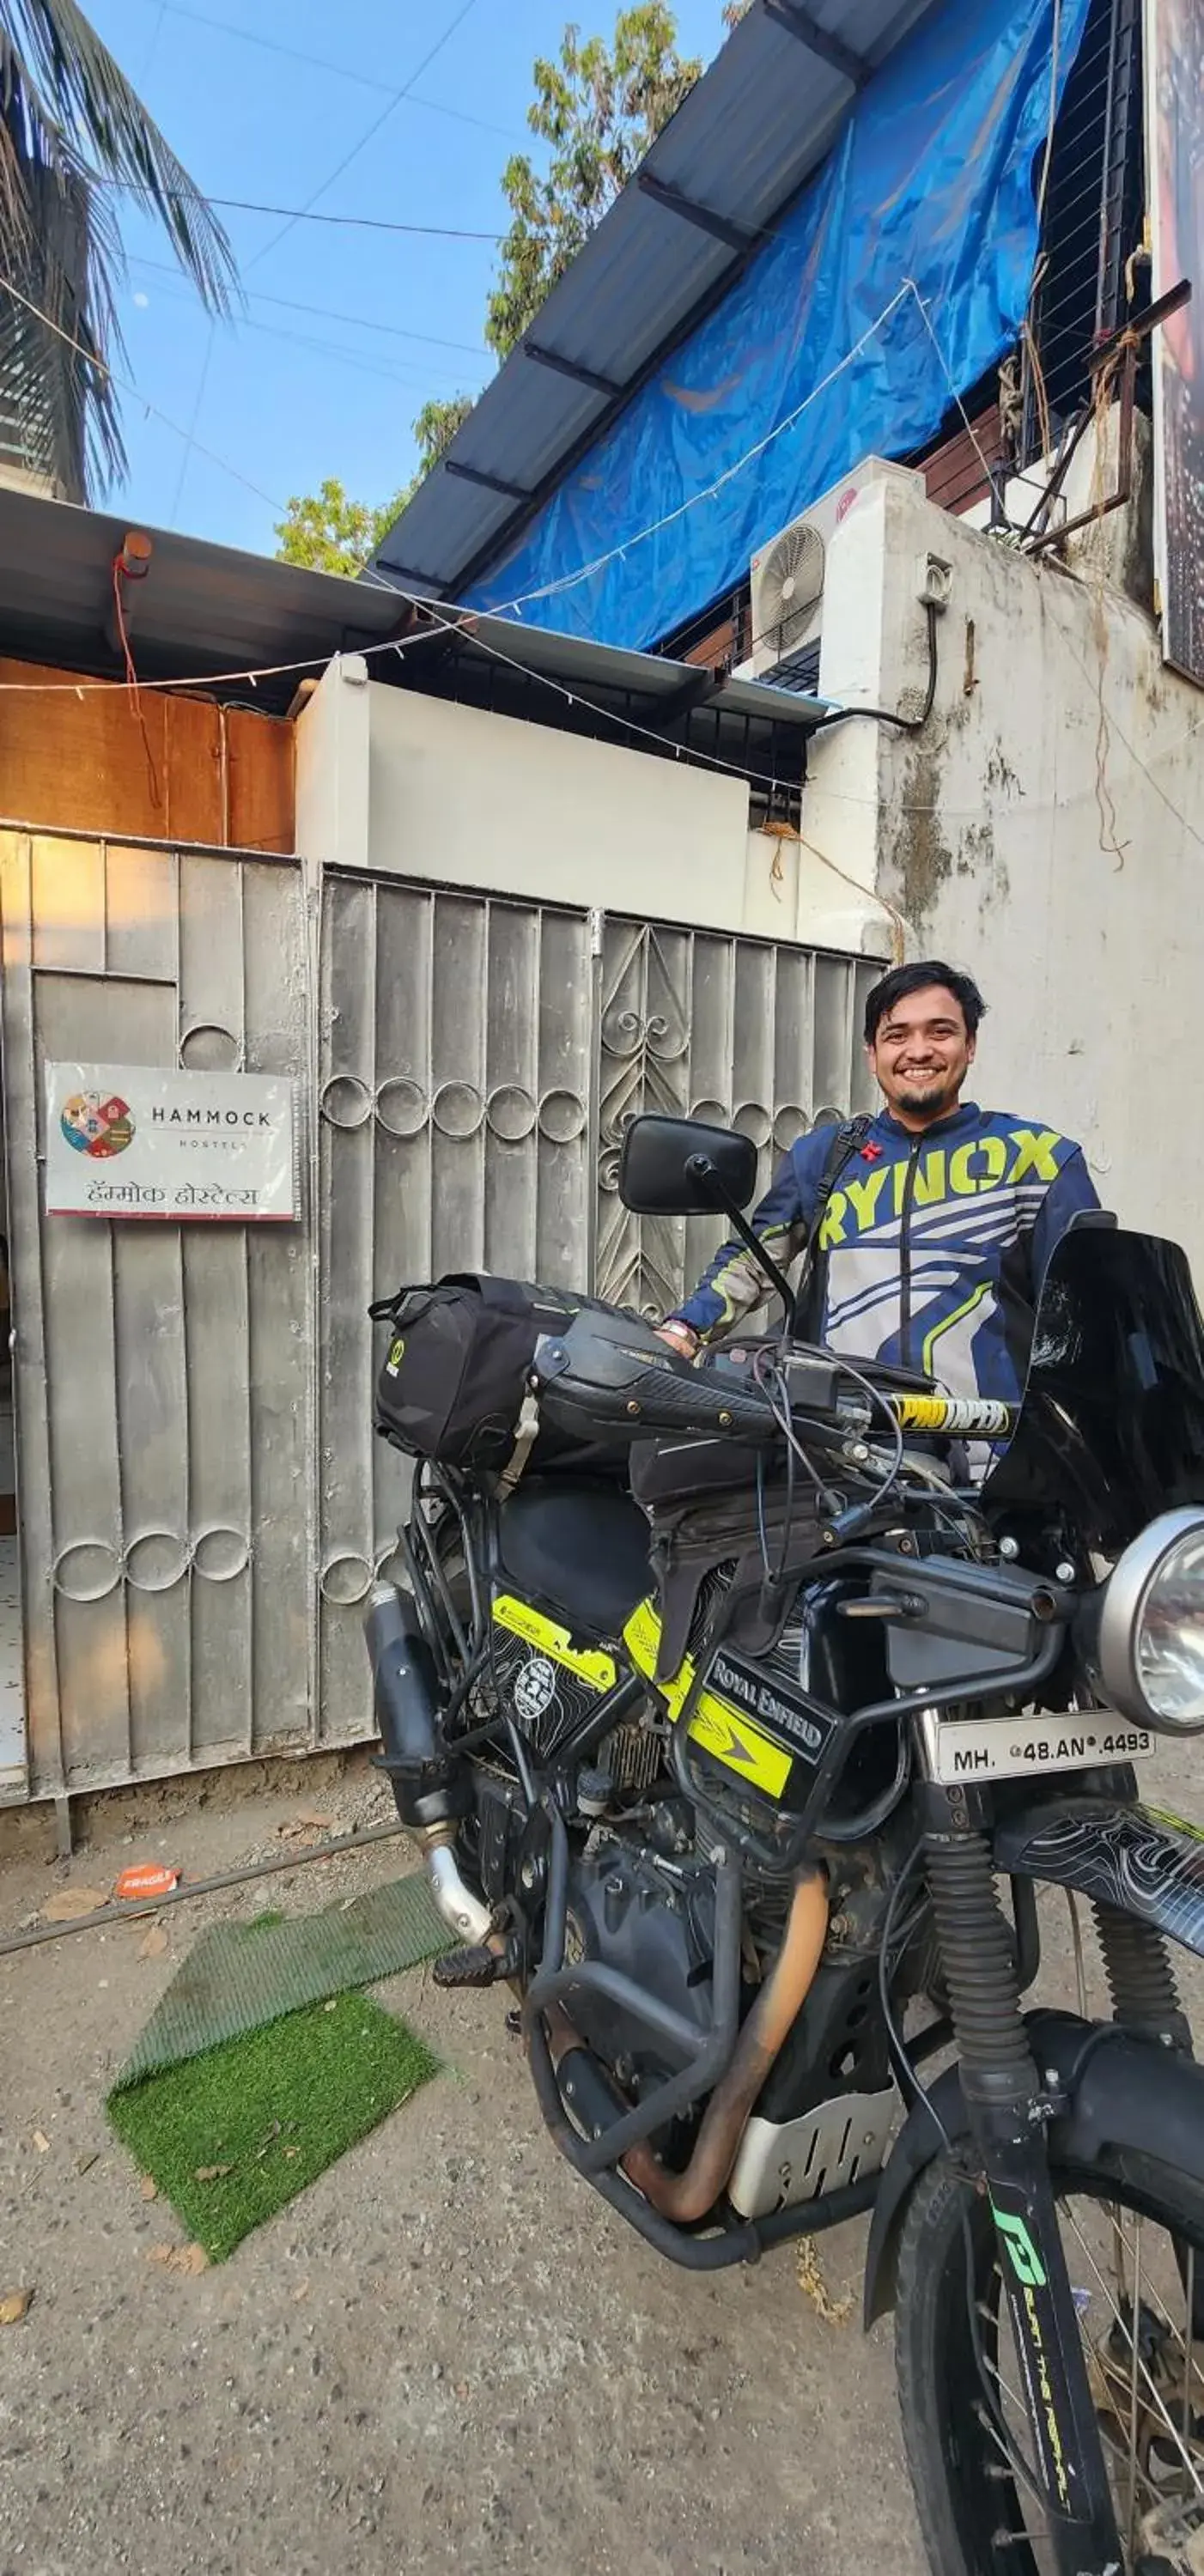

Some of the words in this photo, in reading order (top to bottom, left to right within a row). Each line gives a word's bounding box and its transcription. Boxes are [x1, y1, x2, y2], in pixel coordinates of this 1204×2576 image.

[152, 1107, 271, 1127] HAMMOCK
[818, 1128, 1062, 1251] RYNOX
[714, 1657, 757, 1706] ROYAL
[756, 1689, 823, 1749] ENFIELD
